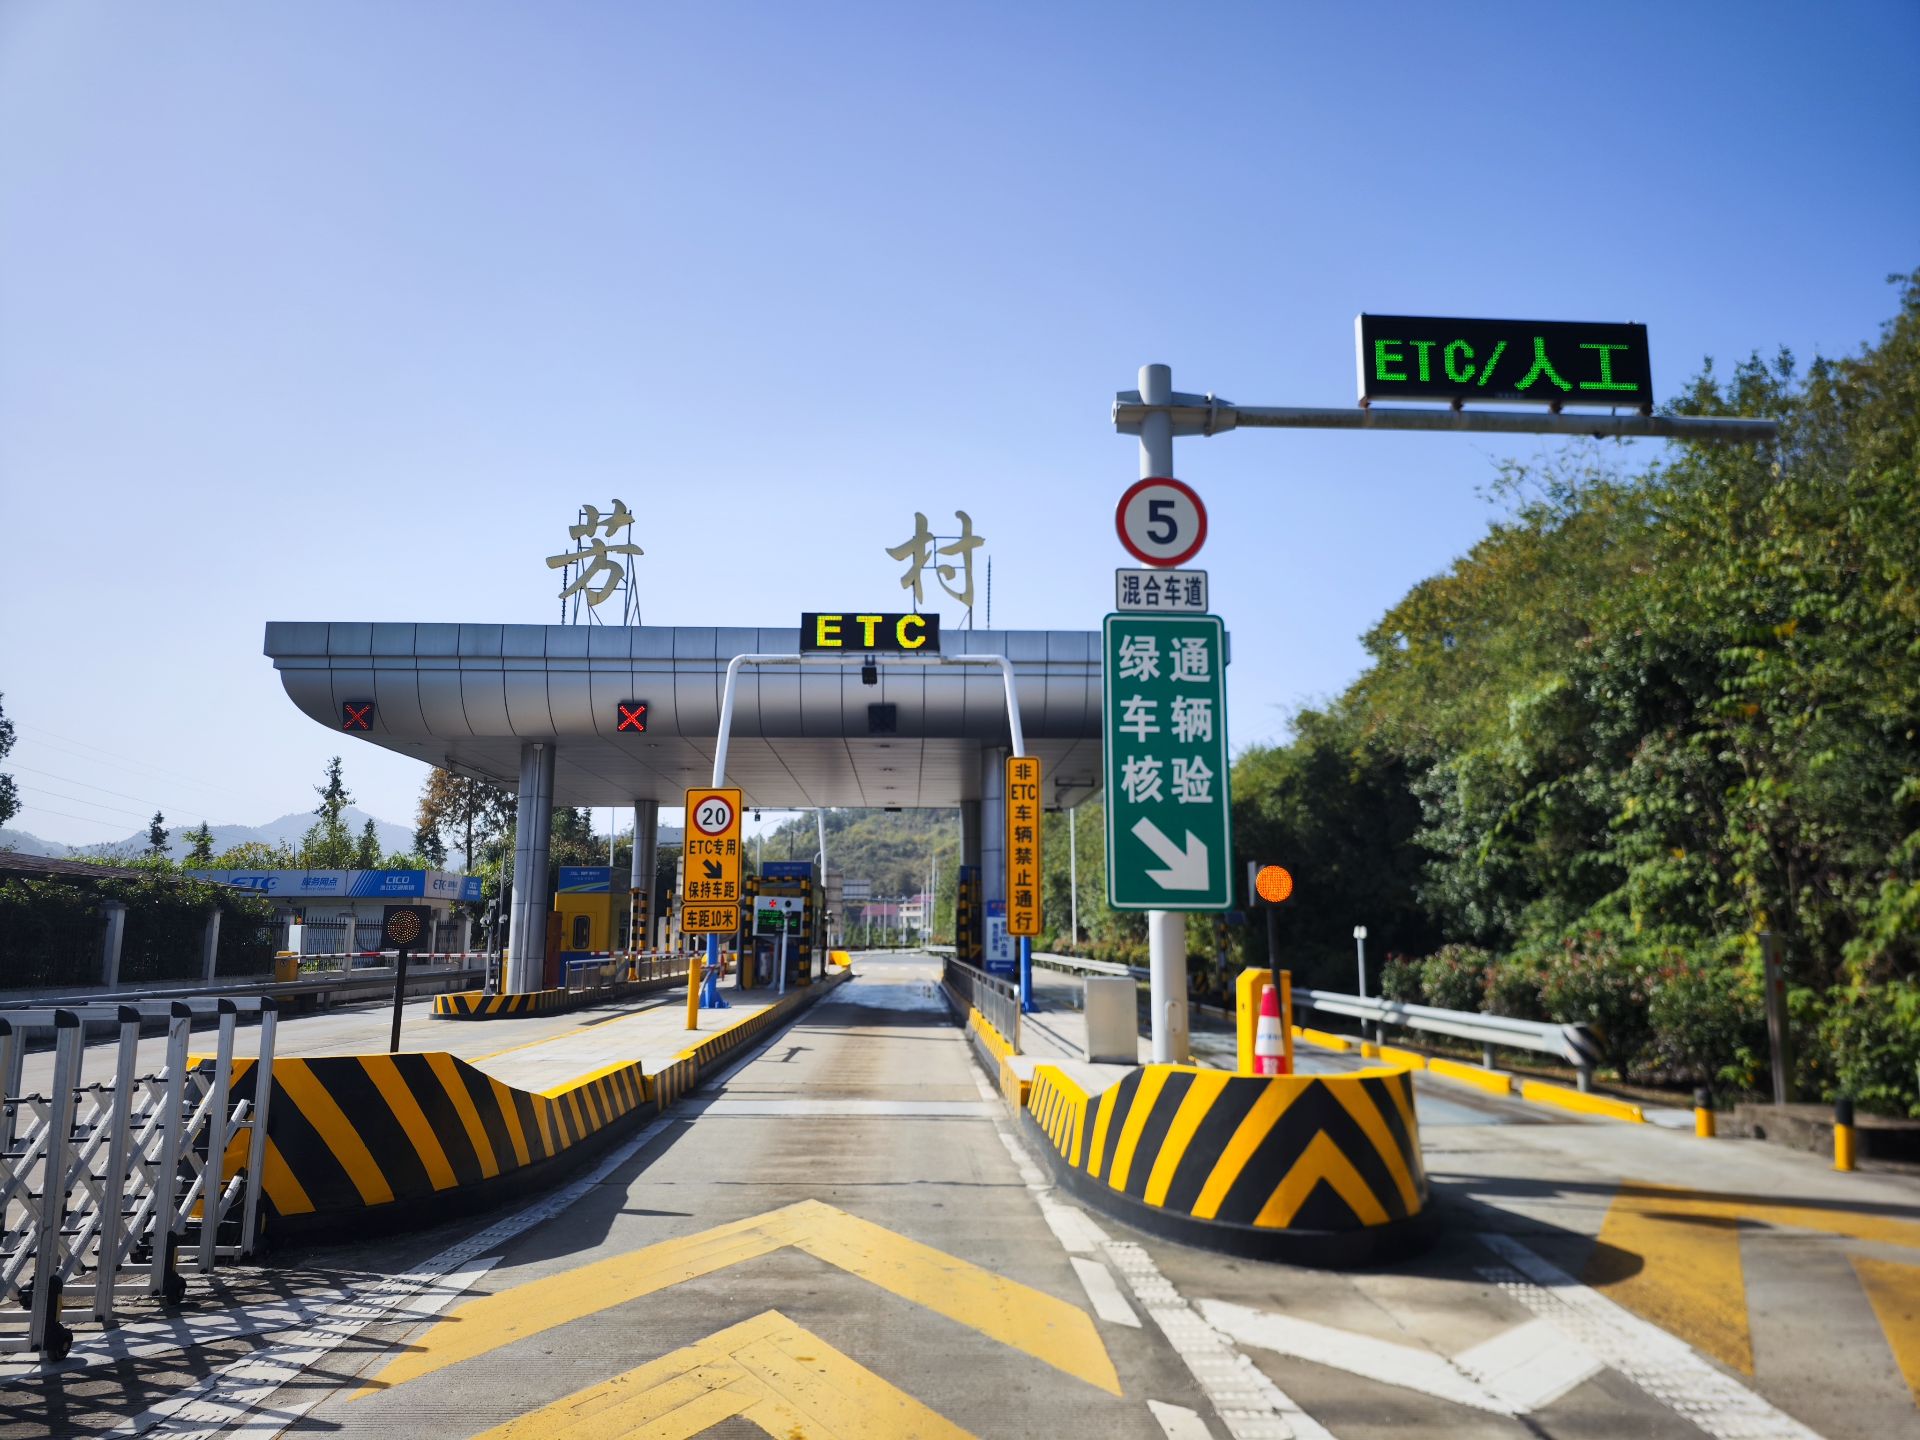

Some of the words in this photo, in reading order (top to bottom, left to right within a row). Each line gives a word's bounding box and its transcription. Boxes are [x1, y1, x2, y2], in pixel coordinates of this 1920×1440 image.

[1375, 336, 1638, 391] ETC/人工
[1146, 500, 1178, 544] 5
[1123, 576, 1202, 606] 混合车道
[816, 615, 926, 649] ETC
[1119, 635, 1211, 682] 绿通
[1119, 694, 1212, 743] 车辆
[1121, 755, 1213, 804] 核验
[702, 807, 726, 825] 20
[689, 839, 736, 856] ETC专用
[688, 881, 735, 899] 保持车距
[687, 909, 733, 928] 车距10米
